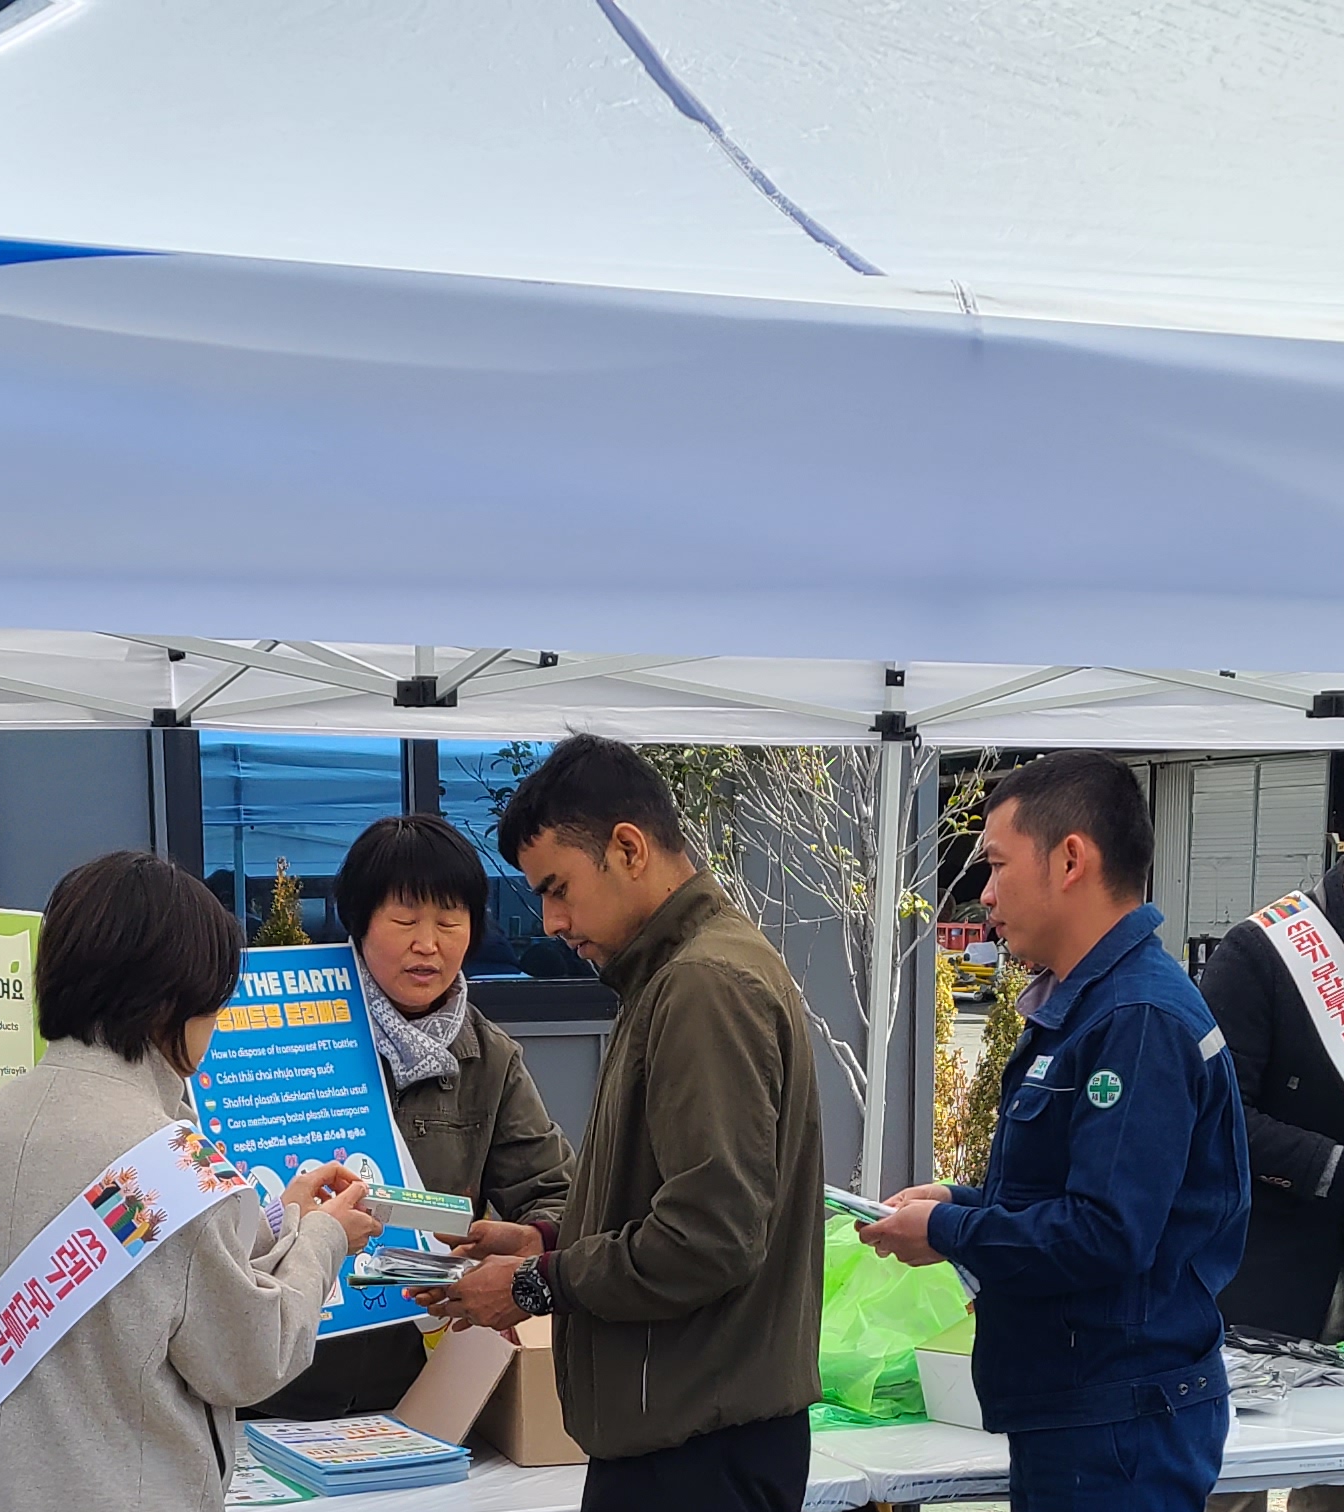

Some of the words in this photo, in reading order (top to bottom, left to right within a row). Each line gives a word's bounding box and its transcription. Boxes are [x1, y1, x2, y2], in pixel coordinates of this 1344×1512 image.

[1286, 919, 1331, 964] 쓰레기
[240, 972, 283, 998] THE
[282, 967, 352, 994] EARTH
[317, 1039, 332, 1051] PET
[45, 1227, 108, 1300] 쓰레기
